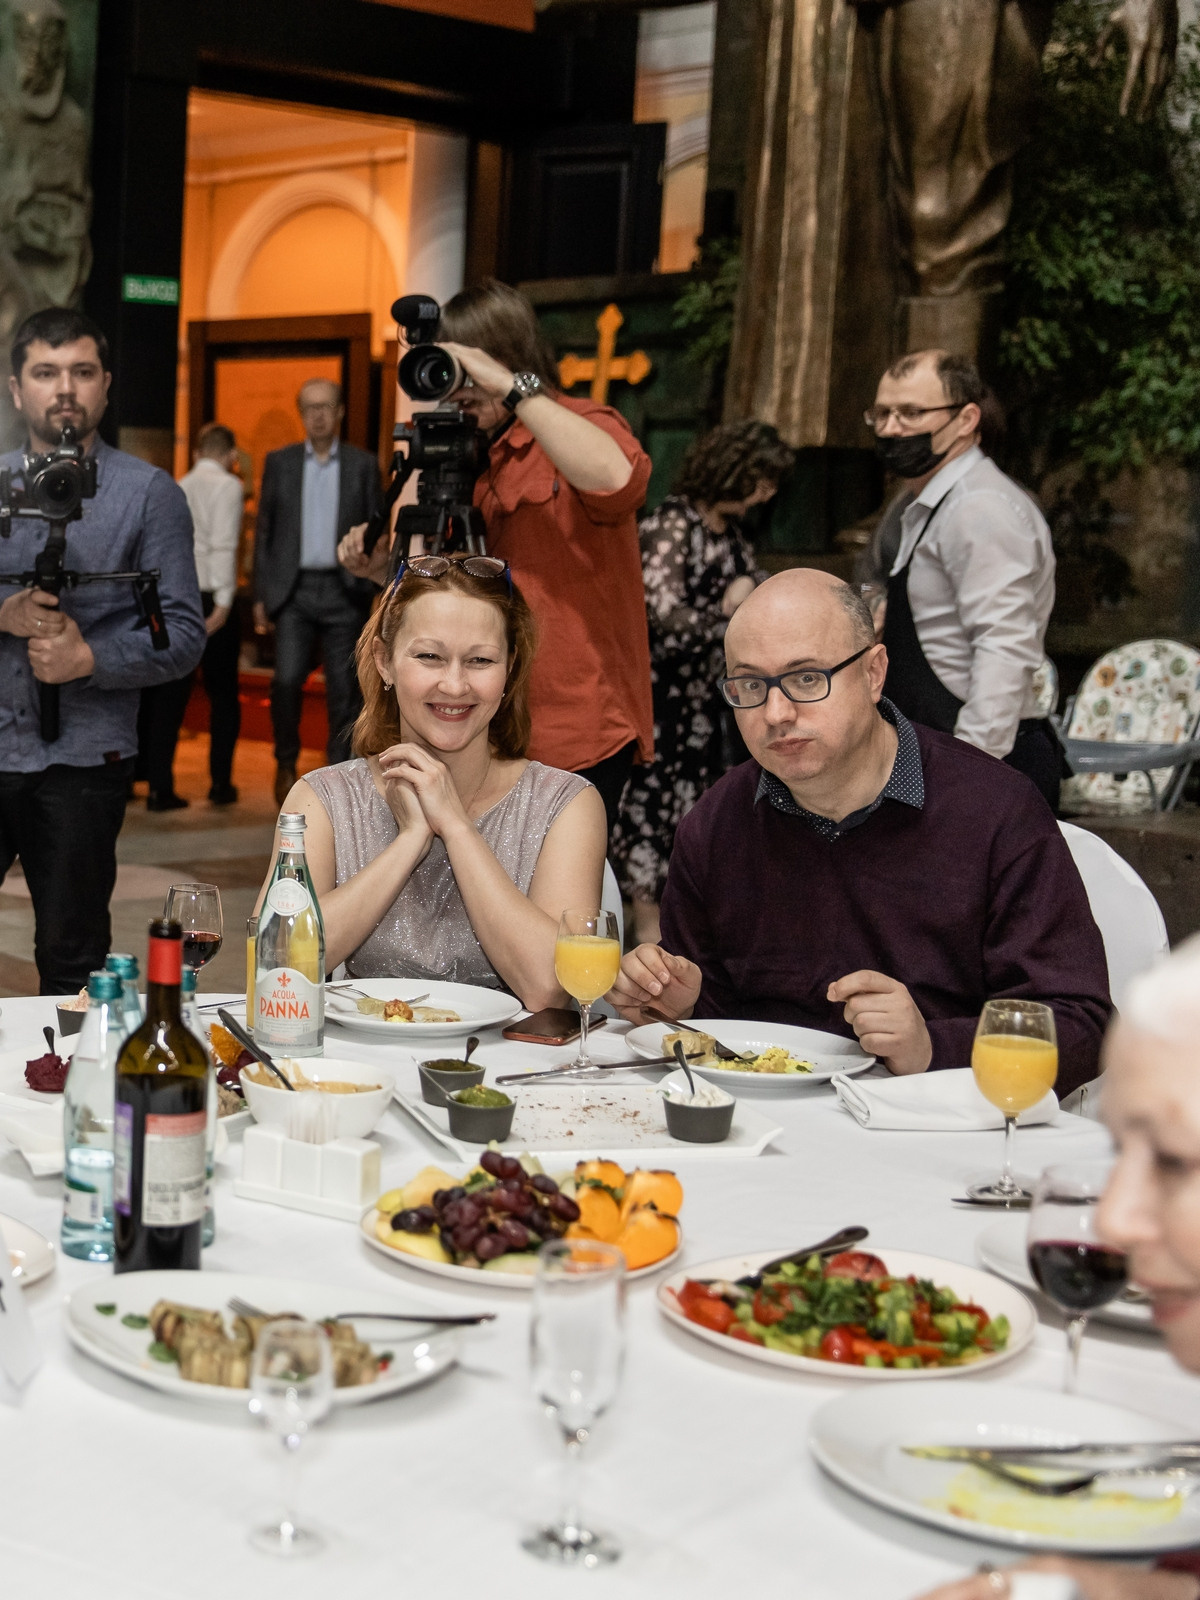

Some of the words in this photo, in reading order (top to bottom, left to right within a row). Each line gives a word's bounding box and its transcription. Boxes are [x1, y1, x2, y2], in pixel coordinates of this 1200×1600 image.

[125, 278, 178, 302] ВЫХОД
[272, 989, 296, 1000] ACQUA
[260, 996, 310, 1019] PANNA
